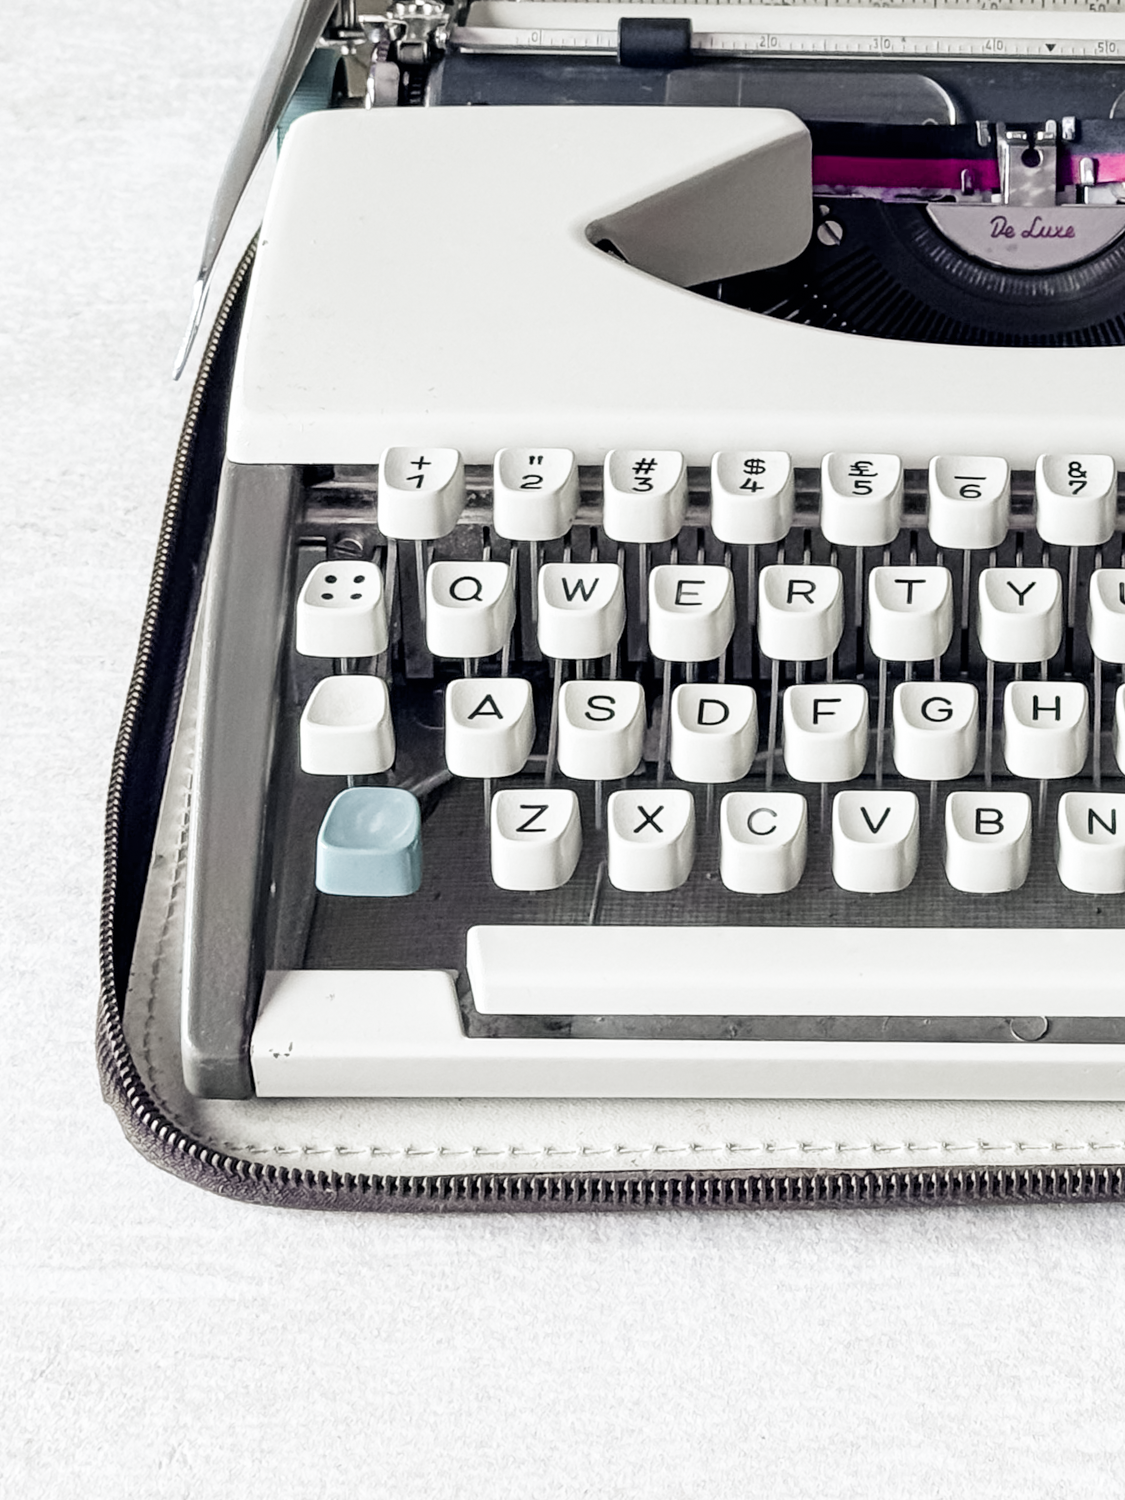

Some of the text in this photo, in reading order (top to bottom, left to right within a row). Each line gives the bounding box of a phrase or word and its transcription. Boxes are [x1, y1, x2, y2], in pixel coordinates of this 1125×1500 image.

[760, 34, 778, 48] 20
[873, 36, 891, 50] 30
[985, 38, 1004, 51] 40
[1097, 40, 1116, 53] 50
[989, 215, 1076, 239] De Luxe
[631, 457, 658, 475] #
[743, 458, 767, 476] $
[847, 460, 879, 478] £
[1067, 460, 1087, 479] &
[406, 474, 425, 489] 1
[519, 474, 544, 490] 2
[632, 476, 654, 493] 3
[739, 477, 765, 493] 4
[851, 479, 873, 496] 5
[959, 483, 982, 499] 6
[1068, 480, 1088, 495] 7
[448, 575, 483, 602] Q
[561, 577, 600, 602] W
[674, 579, 706, 606] E
[786, 579, 817, 605] R
[894, 578, 927, 605] T
[1006, 580, 1037, 606] Y
[467, 693, 504, 720] A
[584, 695, 616, 722] S
[697, 698, 730, 726] D
[812, 698, 842, 725] F
[920, 696, 954, 723] G
[1032, 694, 1061, 722] H
[515, 804, 549, 833] Z
[633, 805, 665, 834] X
[746, 808, 777, 836] C
[860, 806, 891, 835] V
[975, 807, 1005, 836] B
[1087, 808, 1117, 836] N
